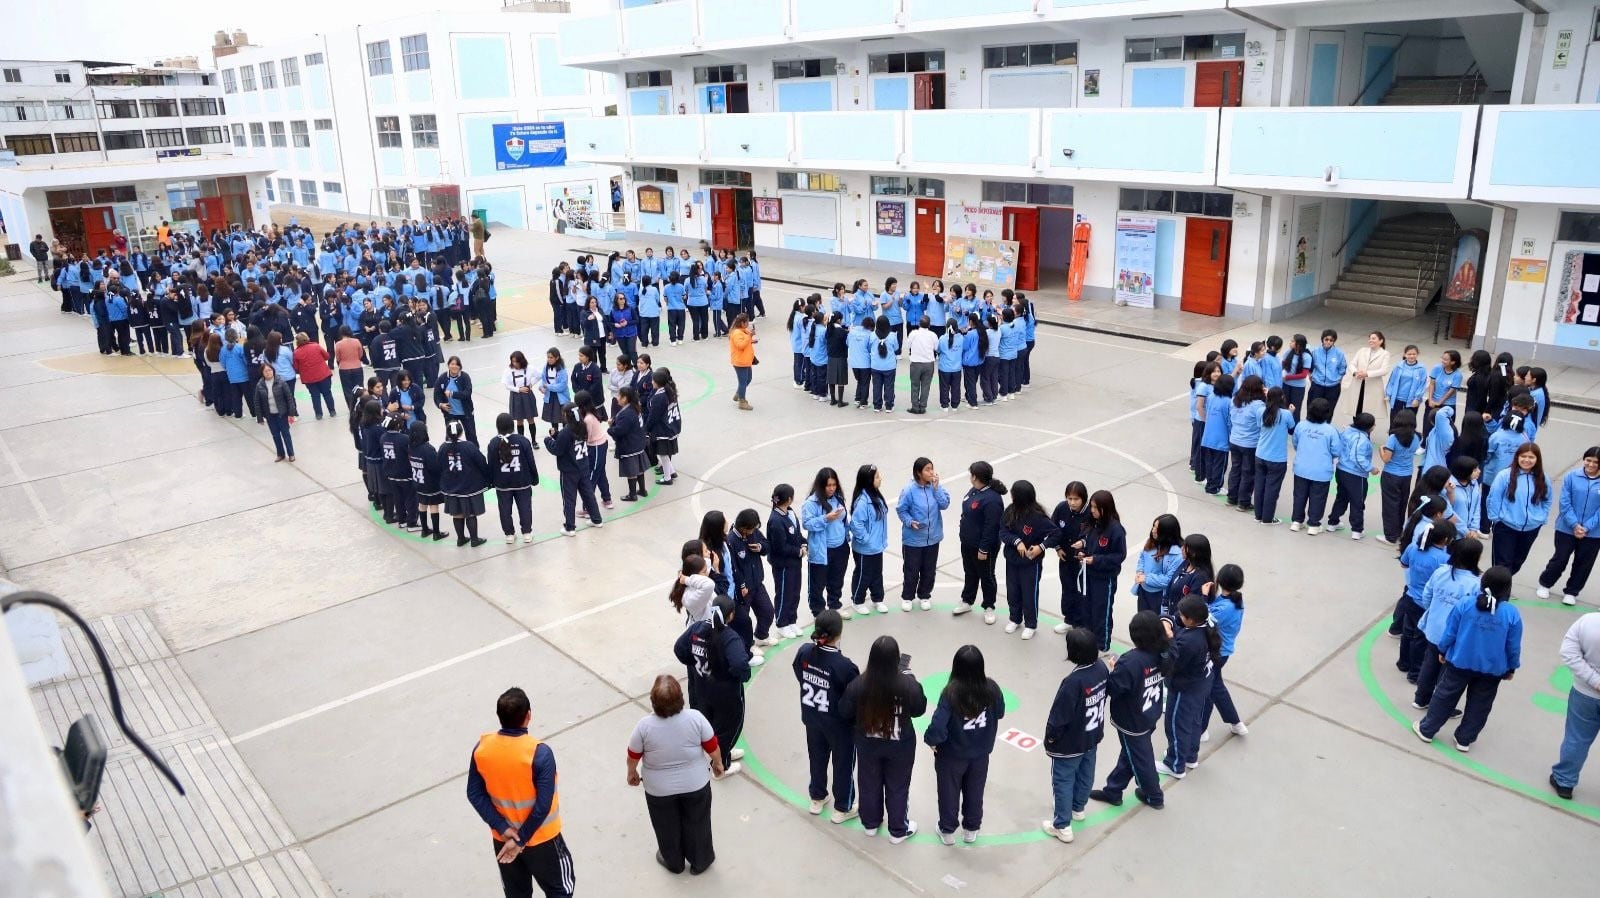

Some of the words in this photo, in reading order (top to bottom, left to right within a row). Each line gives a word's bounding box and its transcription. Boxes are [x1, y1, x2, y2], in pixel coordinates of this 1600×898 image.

[383, 348, 397, 361] 24
[668, 406, 681, 424] 24
[383, 448, 396, 459] 24
[574, 440, 589, 461] 24
[500, 456, 521, 473] 24
[411, 467, 425, 484] 24
[801, 682, 830, 713] 24
[1142, 684, 1161, 713] 24
[963, 710, 988, 730] 24
[1085, 698, 1105, 732] 24
[1006, 730, 1037, 749] 10
